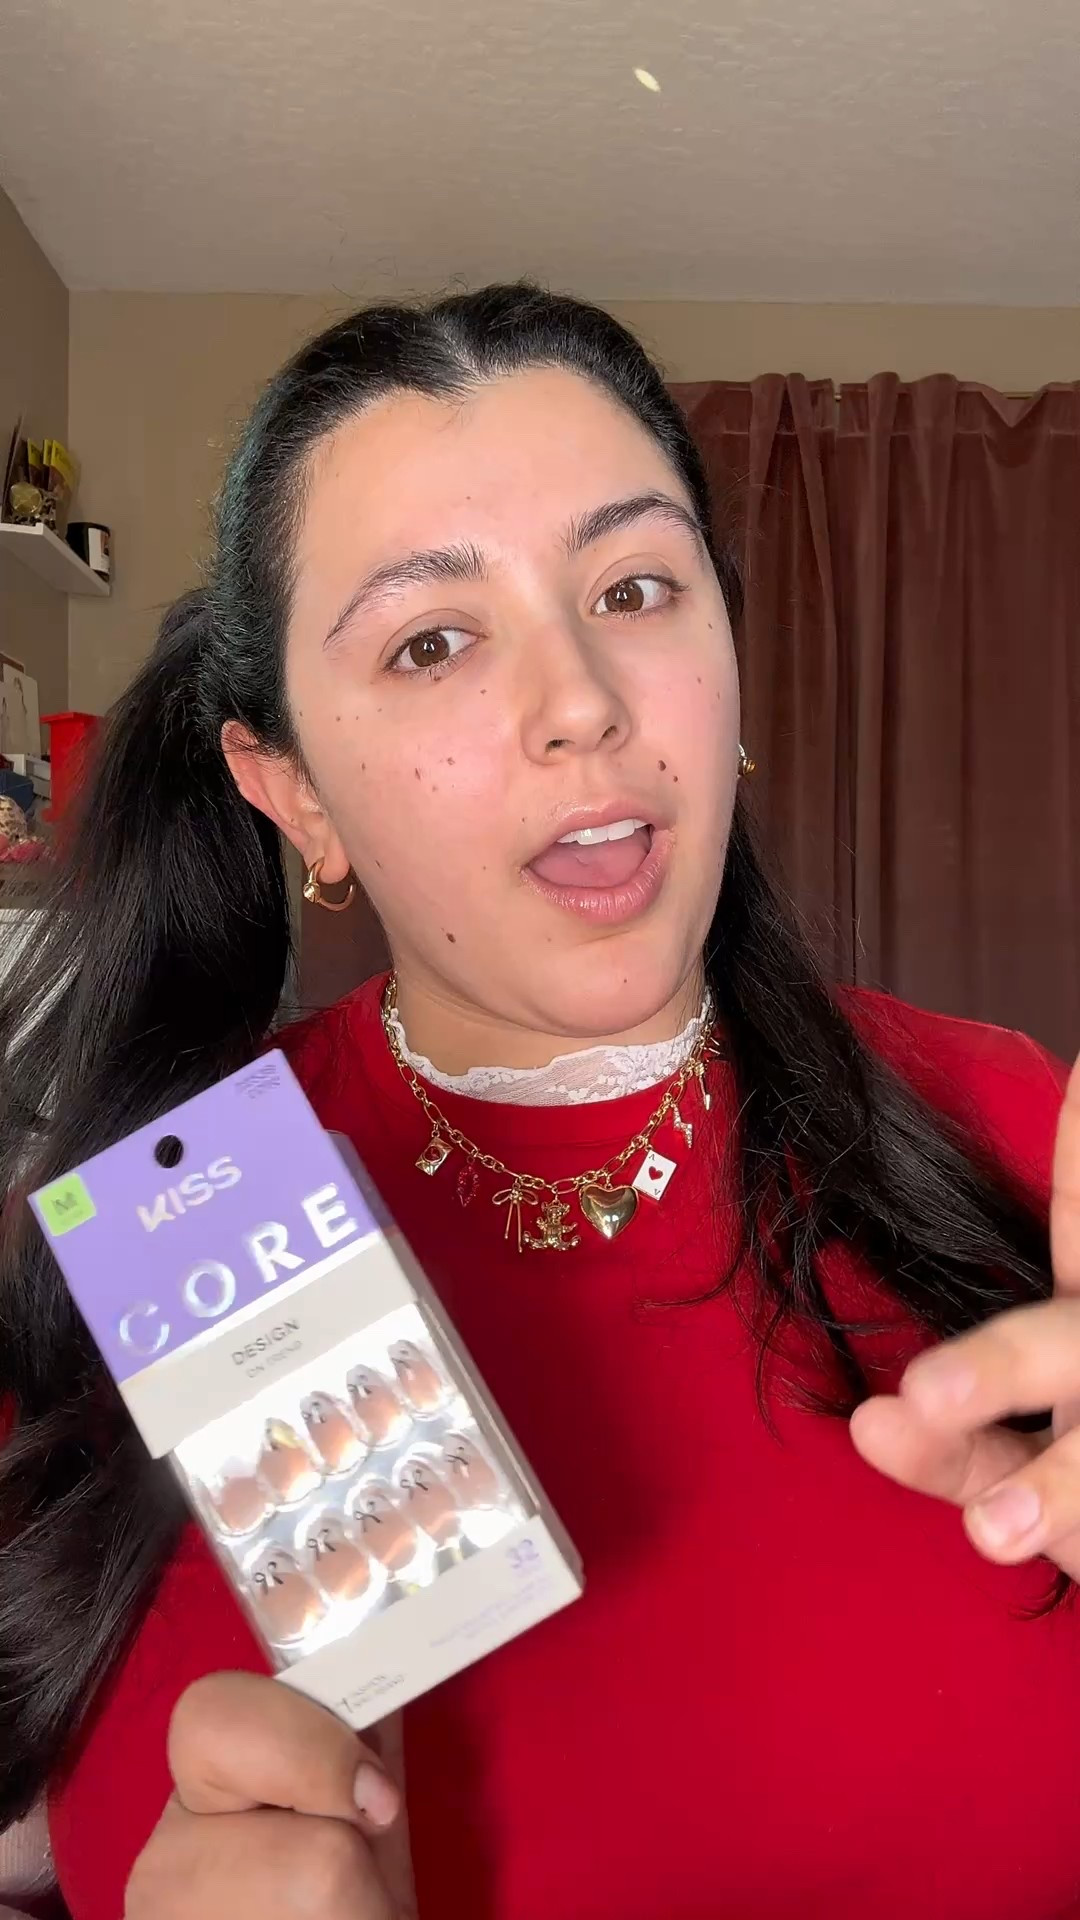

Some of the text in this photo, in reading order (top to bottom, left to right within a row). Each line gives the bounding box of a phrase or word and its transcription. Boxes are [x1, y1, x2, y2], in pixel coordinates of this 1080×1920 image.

[136, 1156, 242, 1232] KISS
[117, 1182, 358, 1354] CORE
[231, 1319, 300, 1366] DESIGN
